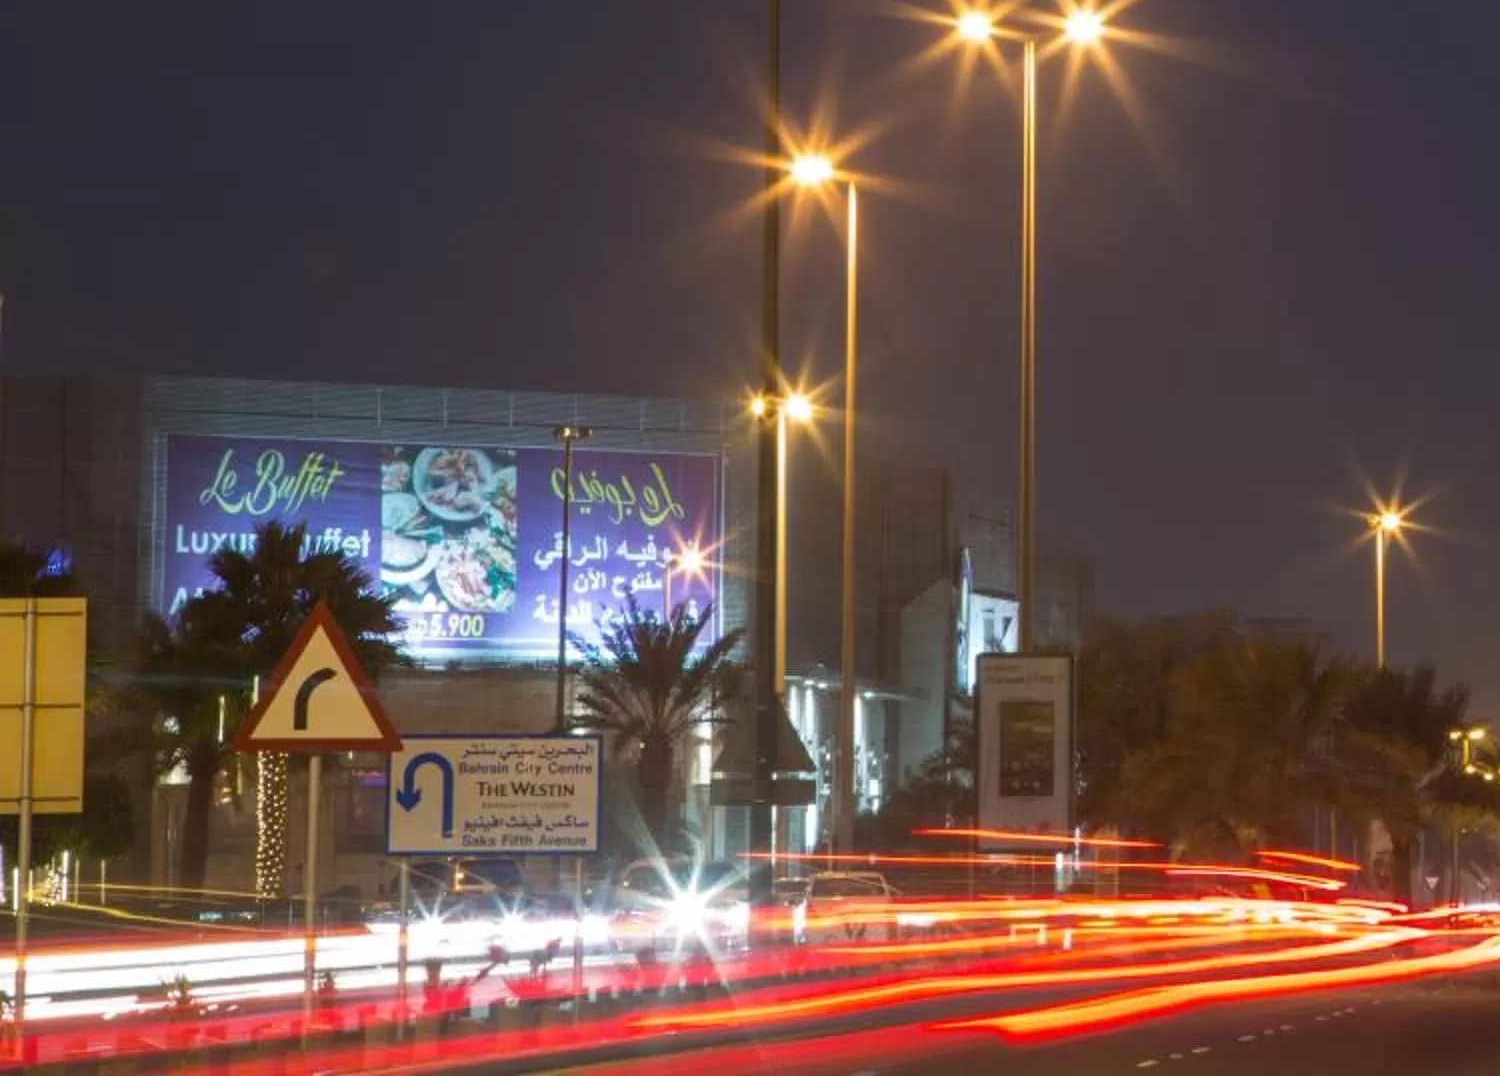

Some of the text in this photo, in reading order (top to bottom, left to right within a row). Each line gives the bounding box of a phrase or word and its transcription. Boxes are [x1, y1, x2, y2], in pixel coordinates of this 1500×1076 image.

[199, 448, 345, 516] Le Buffet
[175, 524, 372, 561] Luxur uffet
[459, 762, 593, 776] Bahrain City Centre
[476, 781, 575, 797] THE WESTIN
[461, 833, 587, 846] Saks Fifth Avenue
